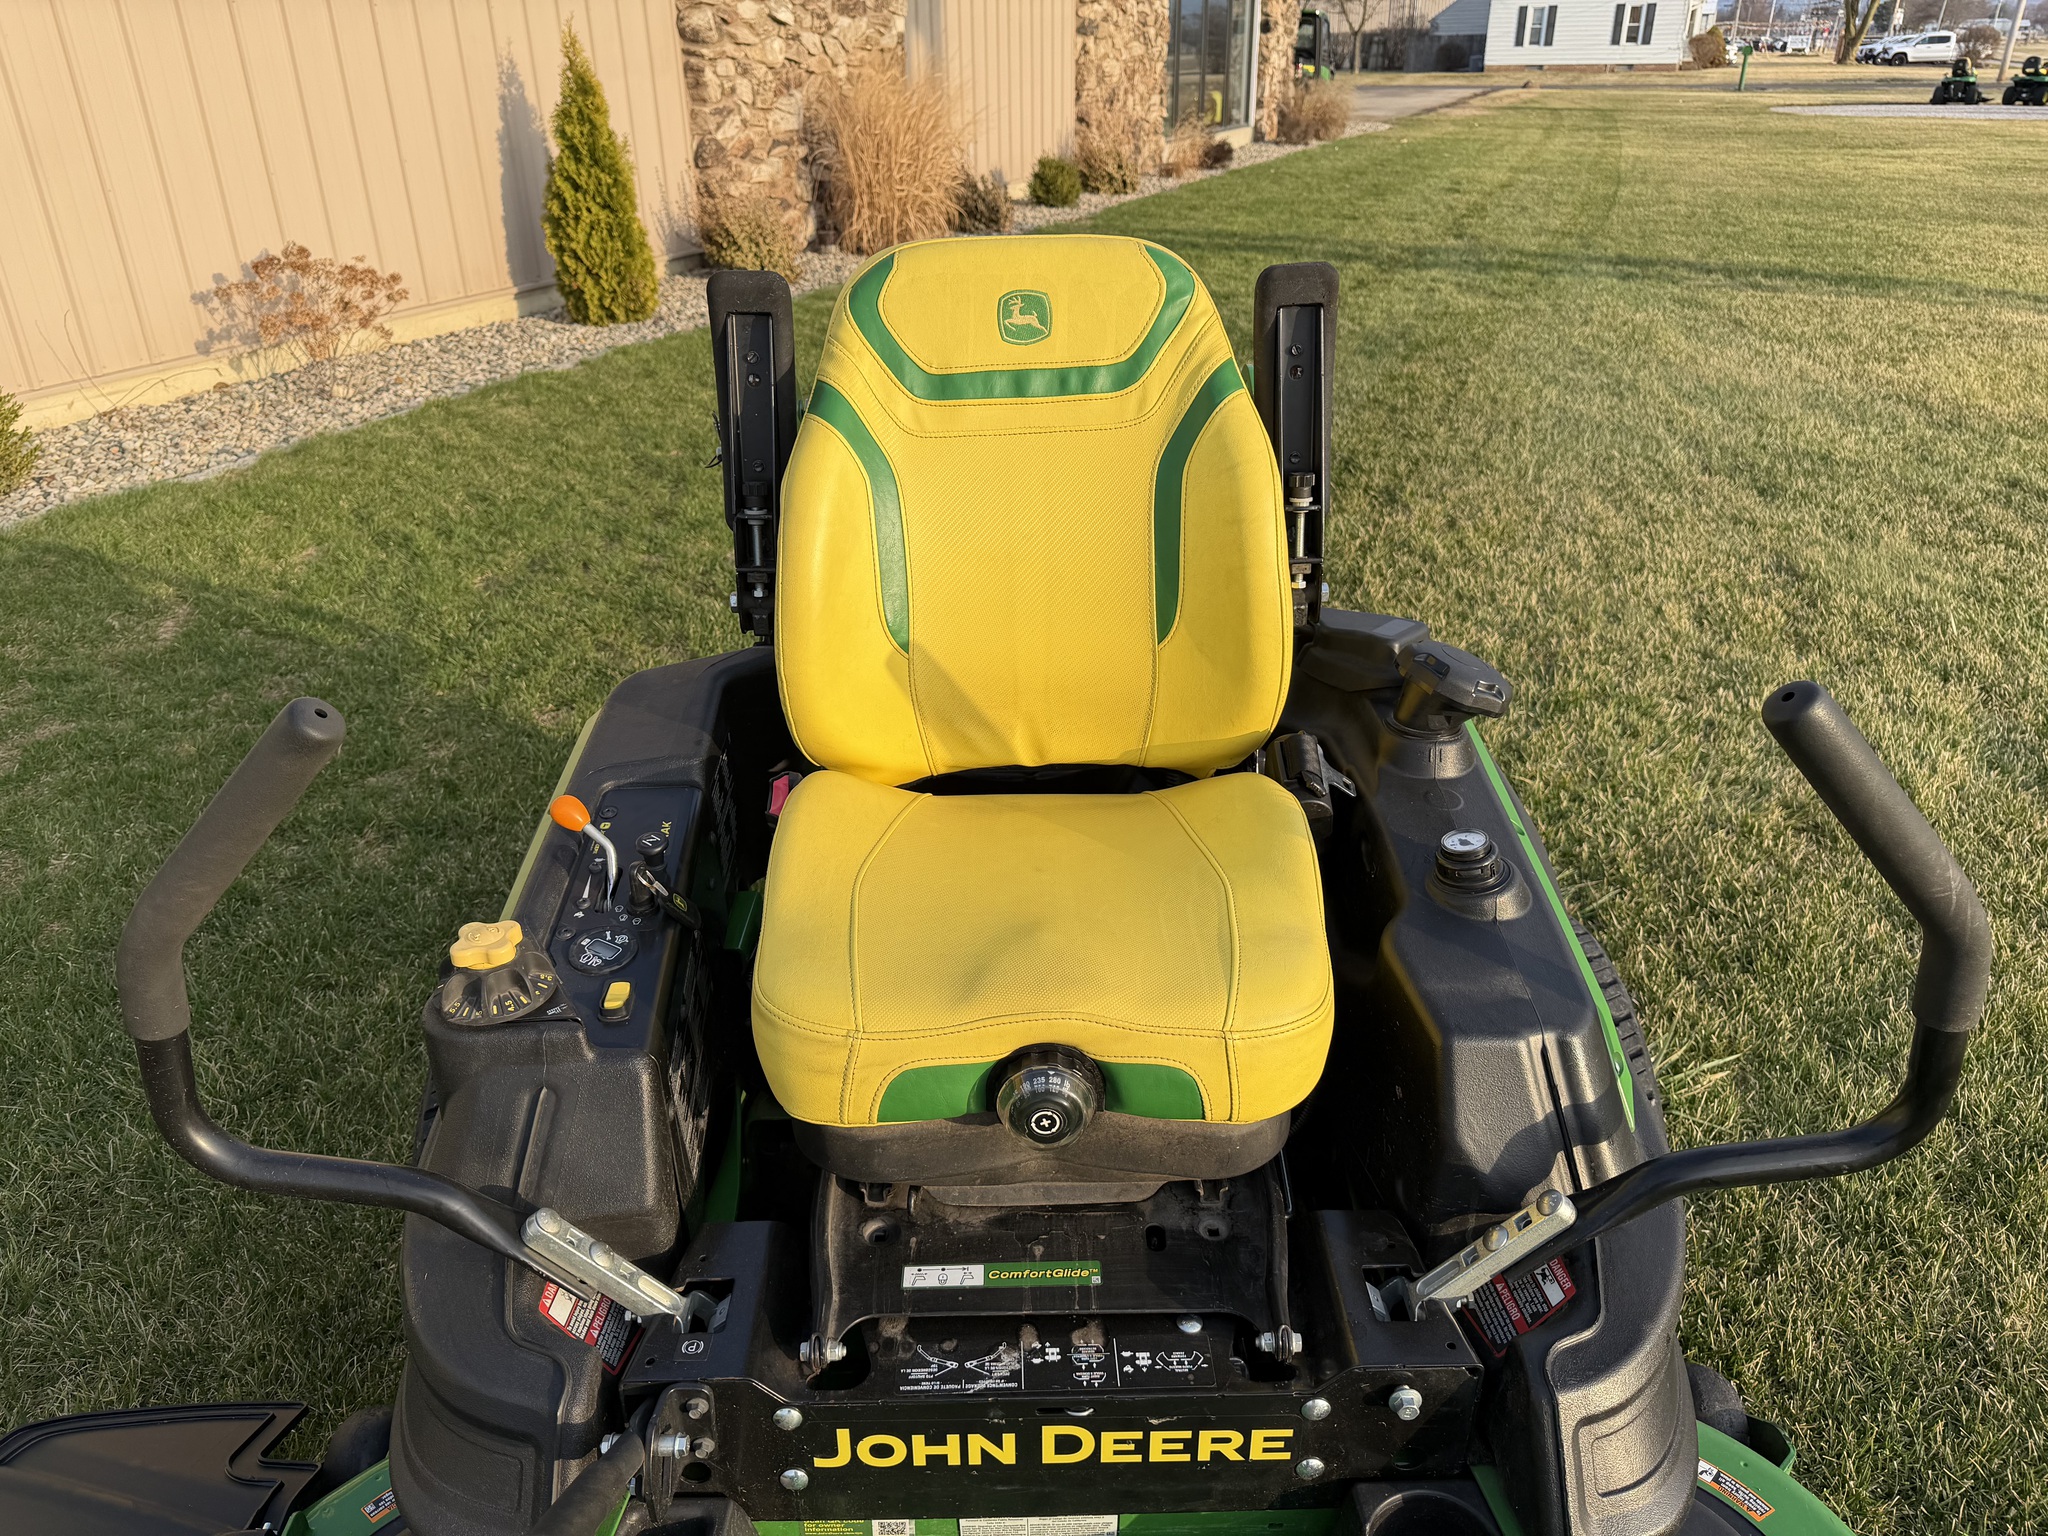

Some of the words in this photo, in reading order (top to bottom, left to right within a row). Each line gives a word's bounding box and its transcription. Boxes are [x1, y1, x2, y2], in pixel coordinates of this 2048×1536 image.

[449, 1001, 460, 1013] 5.5
[504, 1000, 514, 1011] 4.5
[1032, 1076, 1045, 1084] 235
[1048, 1076, 1060, 1084] 280
[1549, 1258, 1571, 1291] DANGER
[545, 1282, 558, 1298] DAN
[595, 1297, 612, 1330] PELIGRO
[1498, 1289, 1520, 1320] PELIGRO
[814, 1429, 1016, 1468] JOHN
[1042, 1426, 1294, 1464] DEERE
[1718, 1487, 1746, 1507] WARNING
